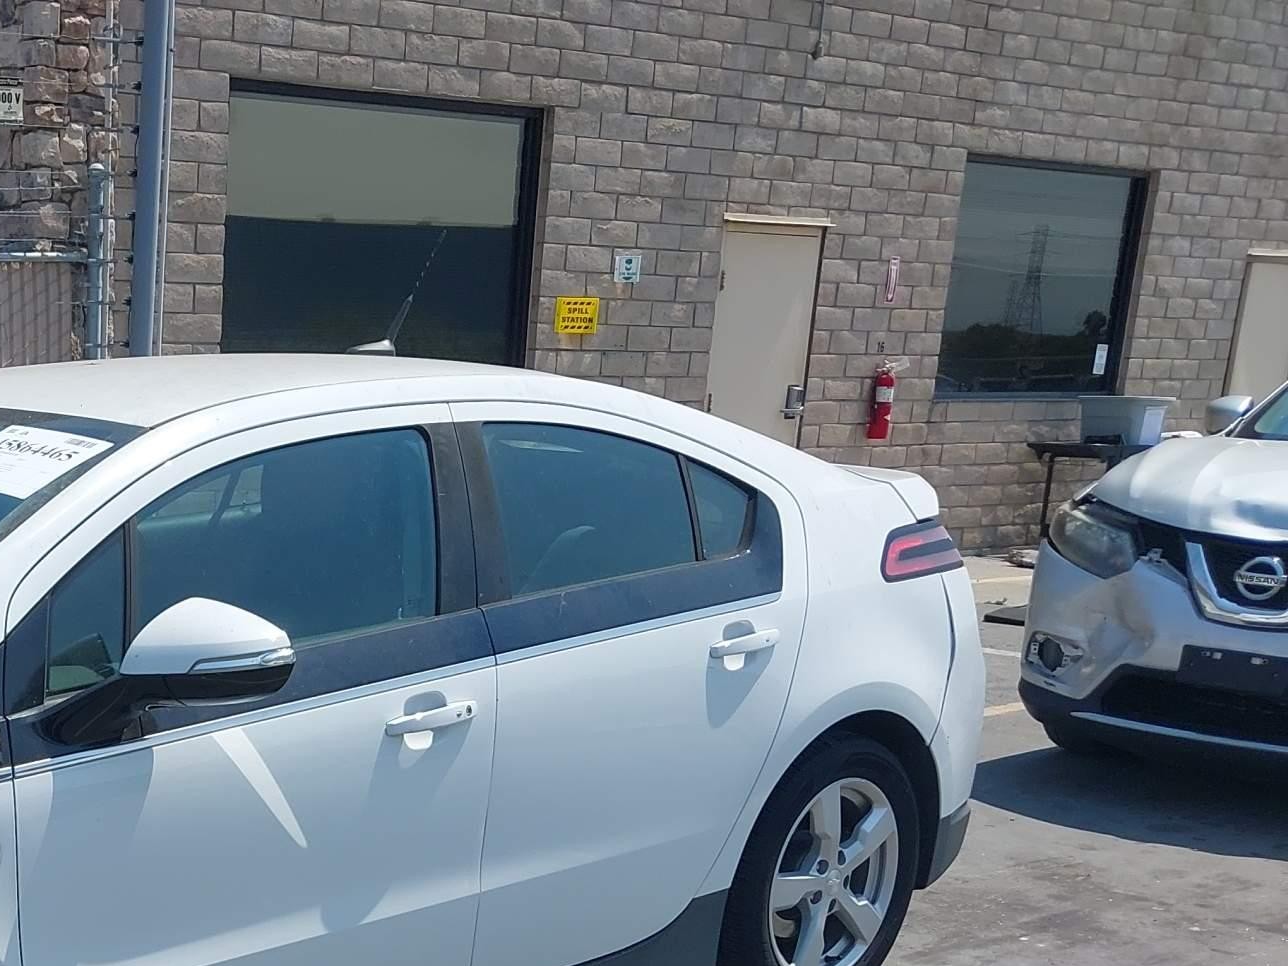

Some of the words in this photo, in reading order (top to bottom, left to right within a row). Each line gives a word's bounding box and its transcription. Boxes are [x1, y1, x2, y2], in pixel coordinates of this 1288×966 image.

[14, 92, 21, 105] V
[567, 307, 589, 315] SPILL
[561, 316, 594, 324] STATION
[876, 341, 885, 353] 16
[1236, 573, 1280, 585] NISSAN
